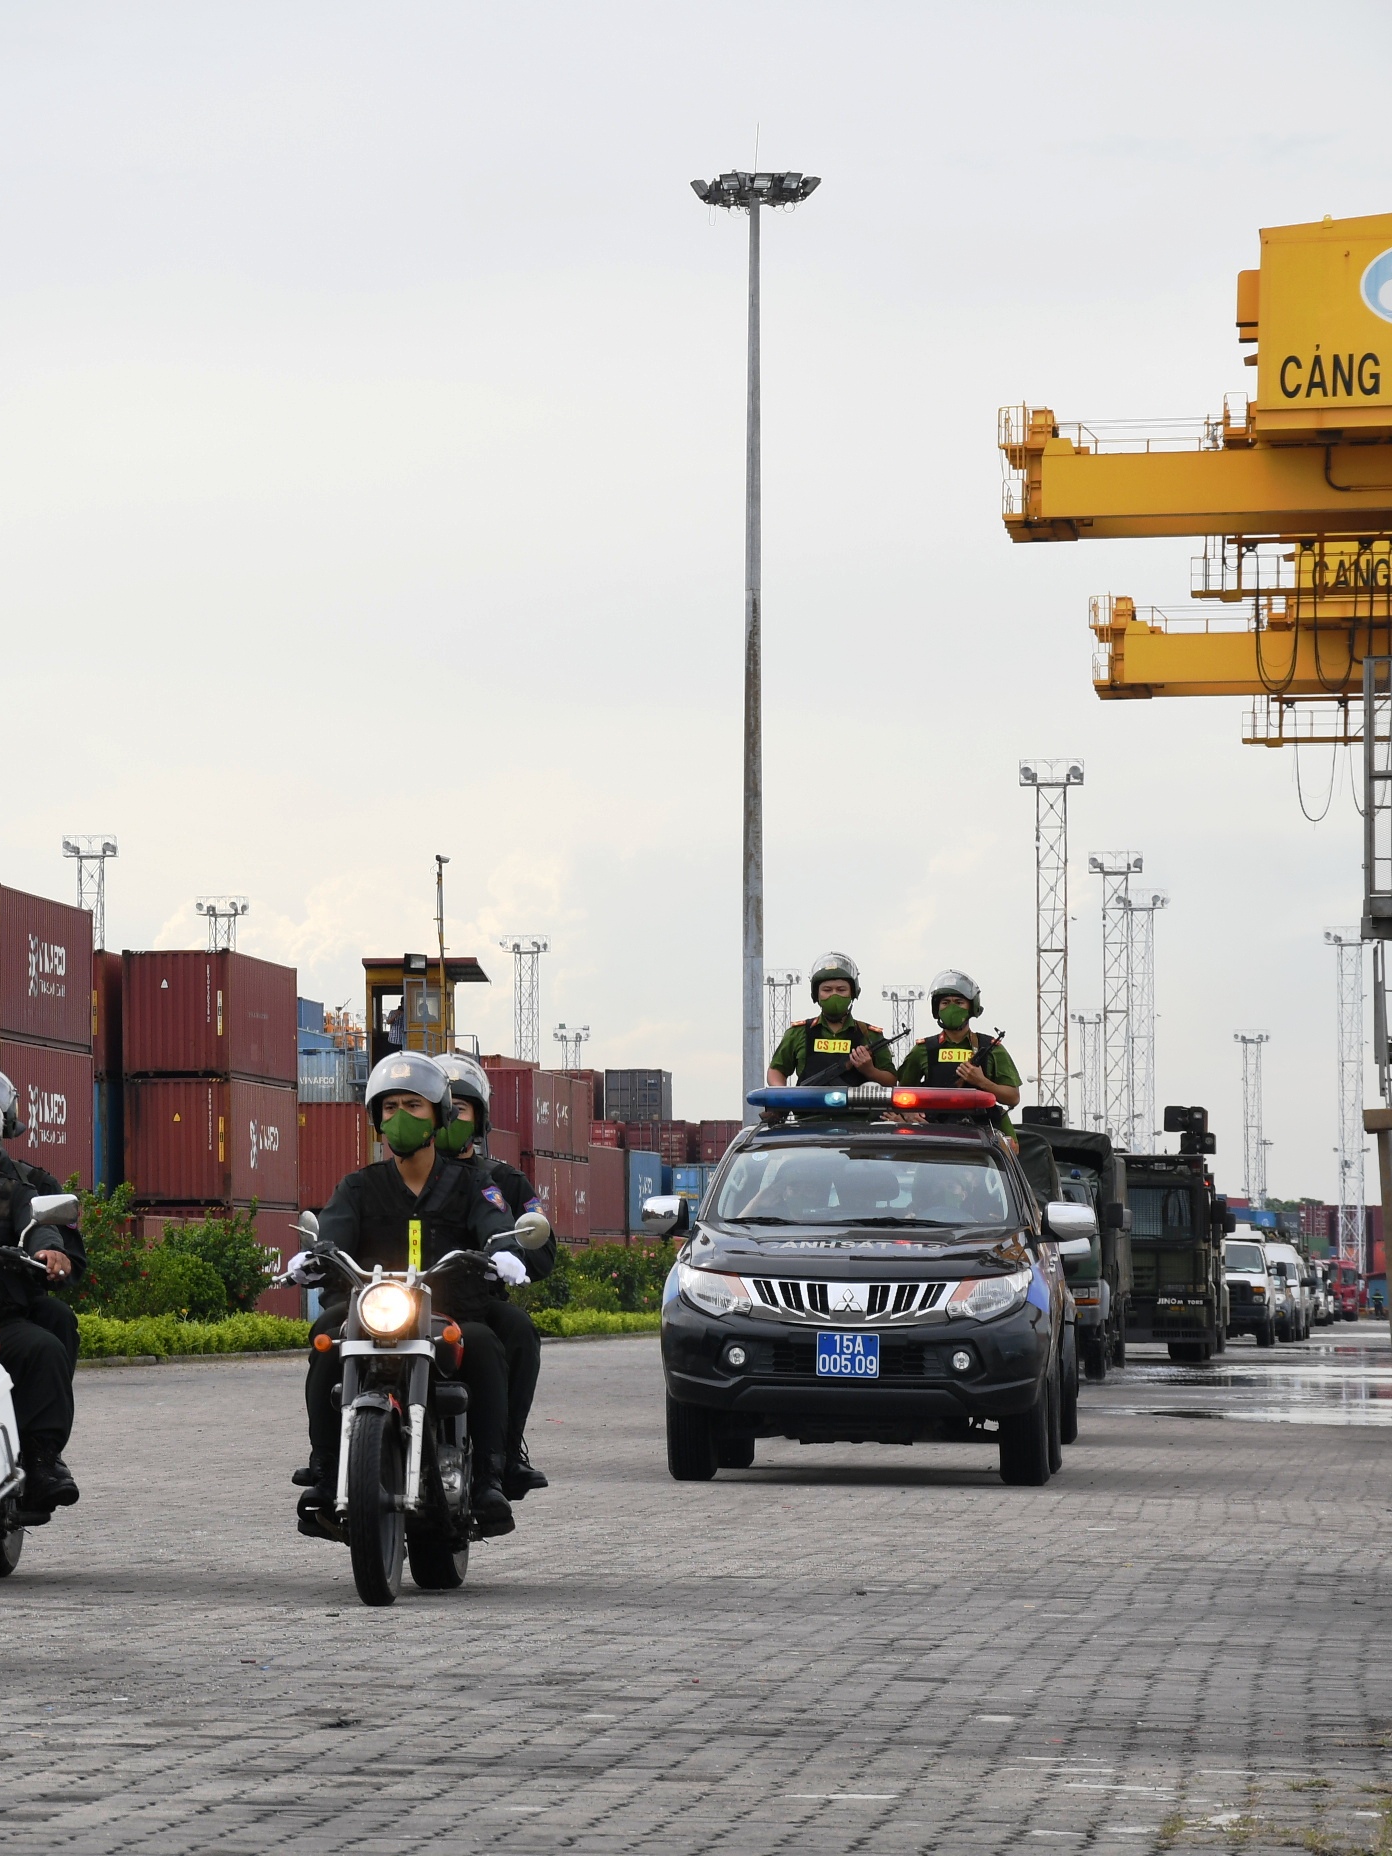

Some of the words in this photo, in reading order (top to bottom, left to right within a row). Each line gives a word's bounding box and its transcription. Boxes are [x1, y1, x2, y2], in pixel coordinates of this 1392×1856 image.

[1280, 344, 1381, 398] CẢNG
[816, 1040, 829, 1050] CS
[833, 1041, 849, 1052] 113
[941, 1050, 953, 1061] CS
[833, 1334, 865, 1355] 15A
[818, 1354, 878, 1375] 005.09
